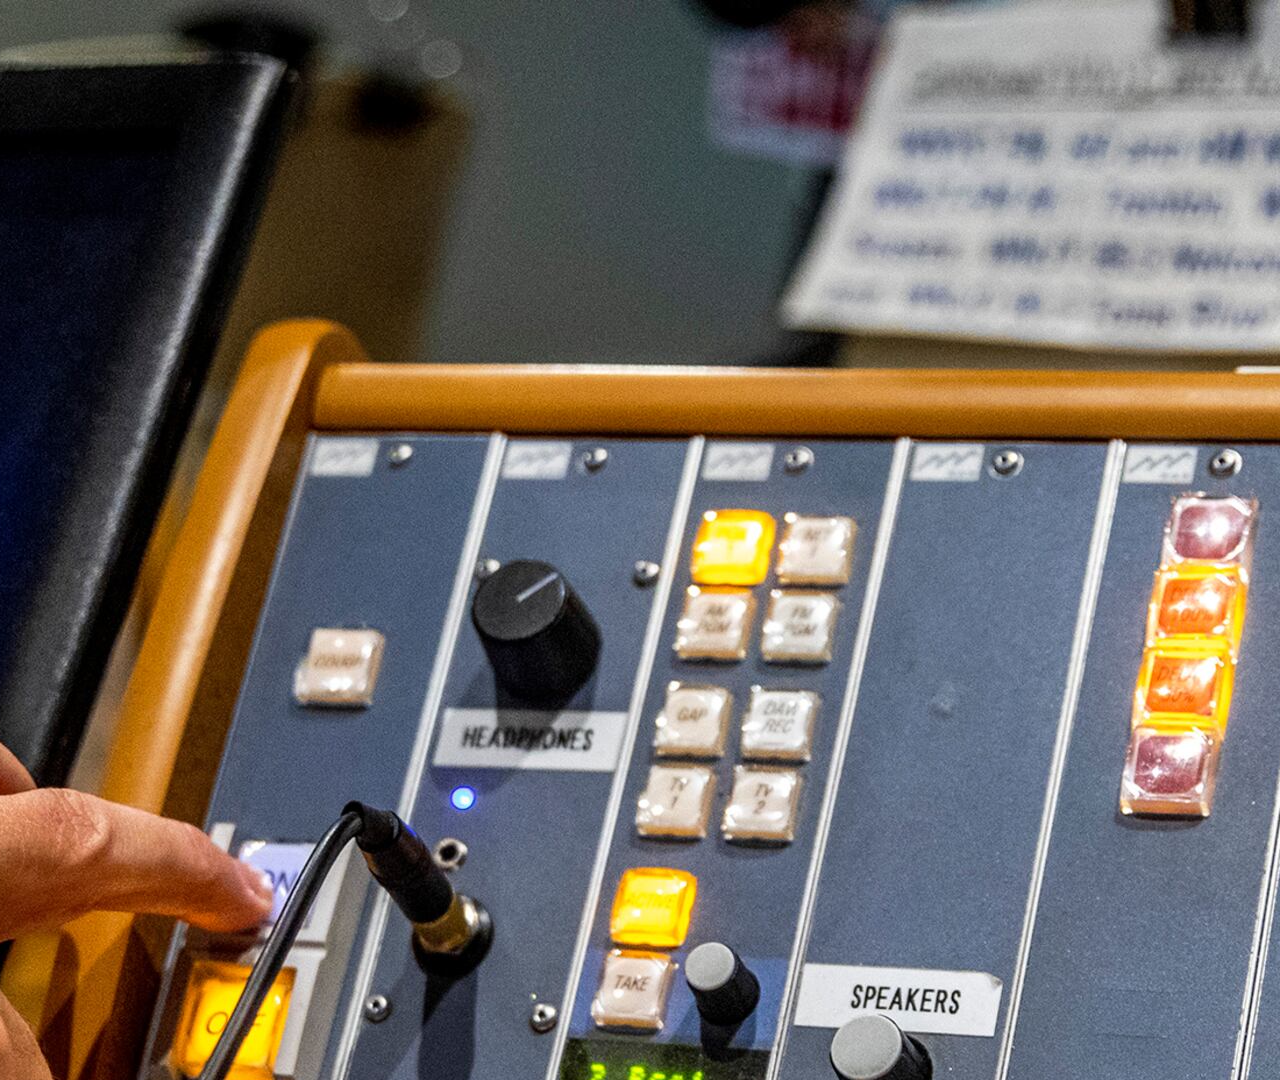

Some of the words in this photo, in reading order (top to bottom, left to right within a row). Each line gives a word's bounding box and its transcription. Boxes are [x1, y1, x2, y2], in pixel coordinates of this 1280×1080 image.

[461, 725, 595, 751] HEADPHONES
[614, 974, 651, 992] TAKE
[850, 984, 962, 1014] SPEAKERS
